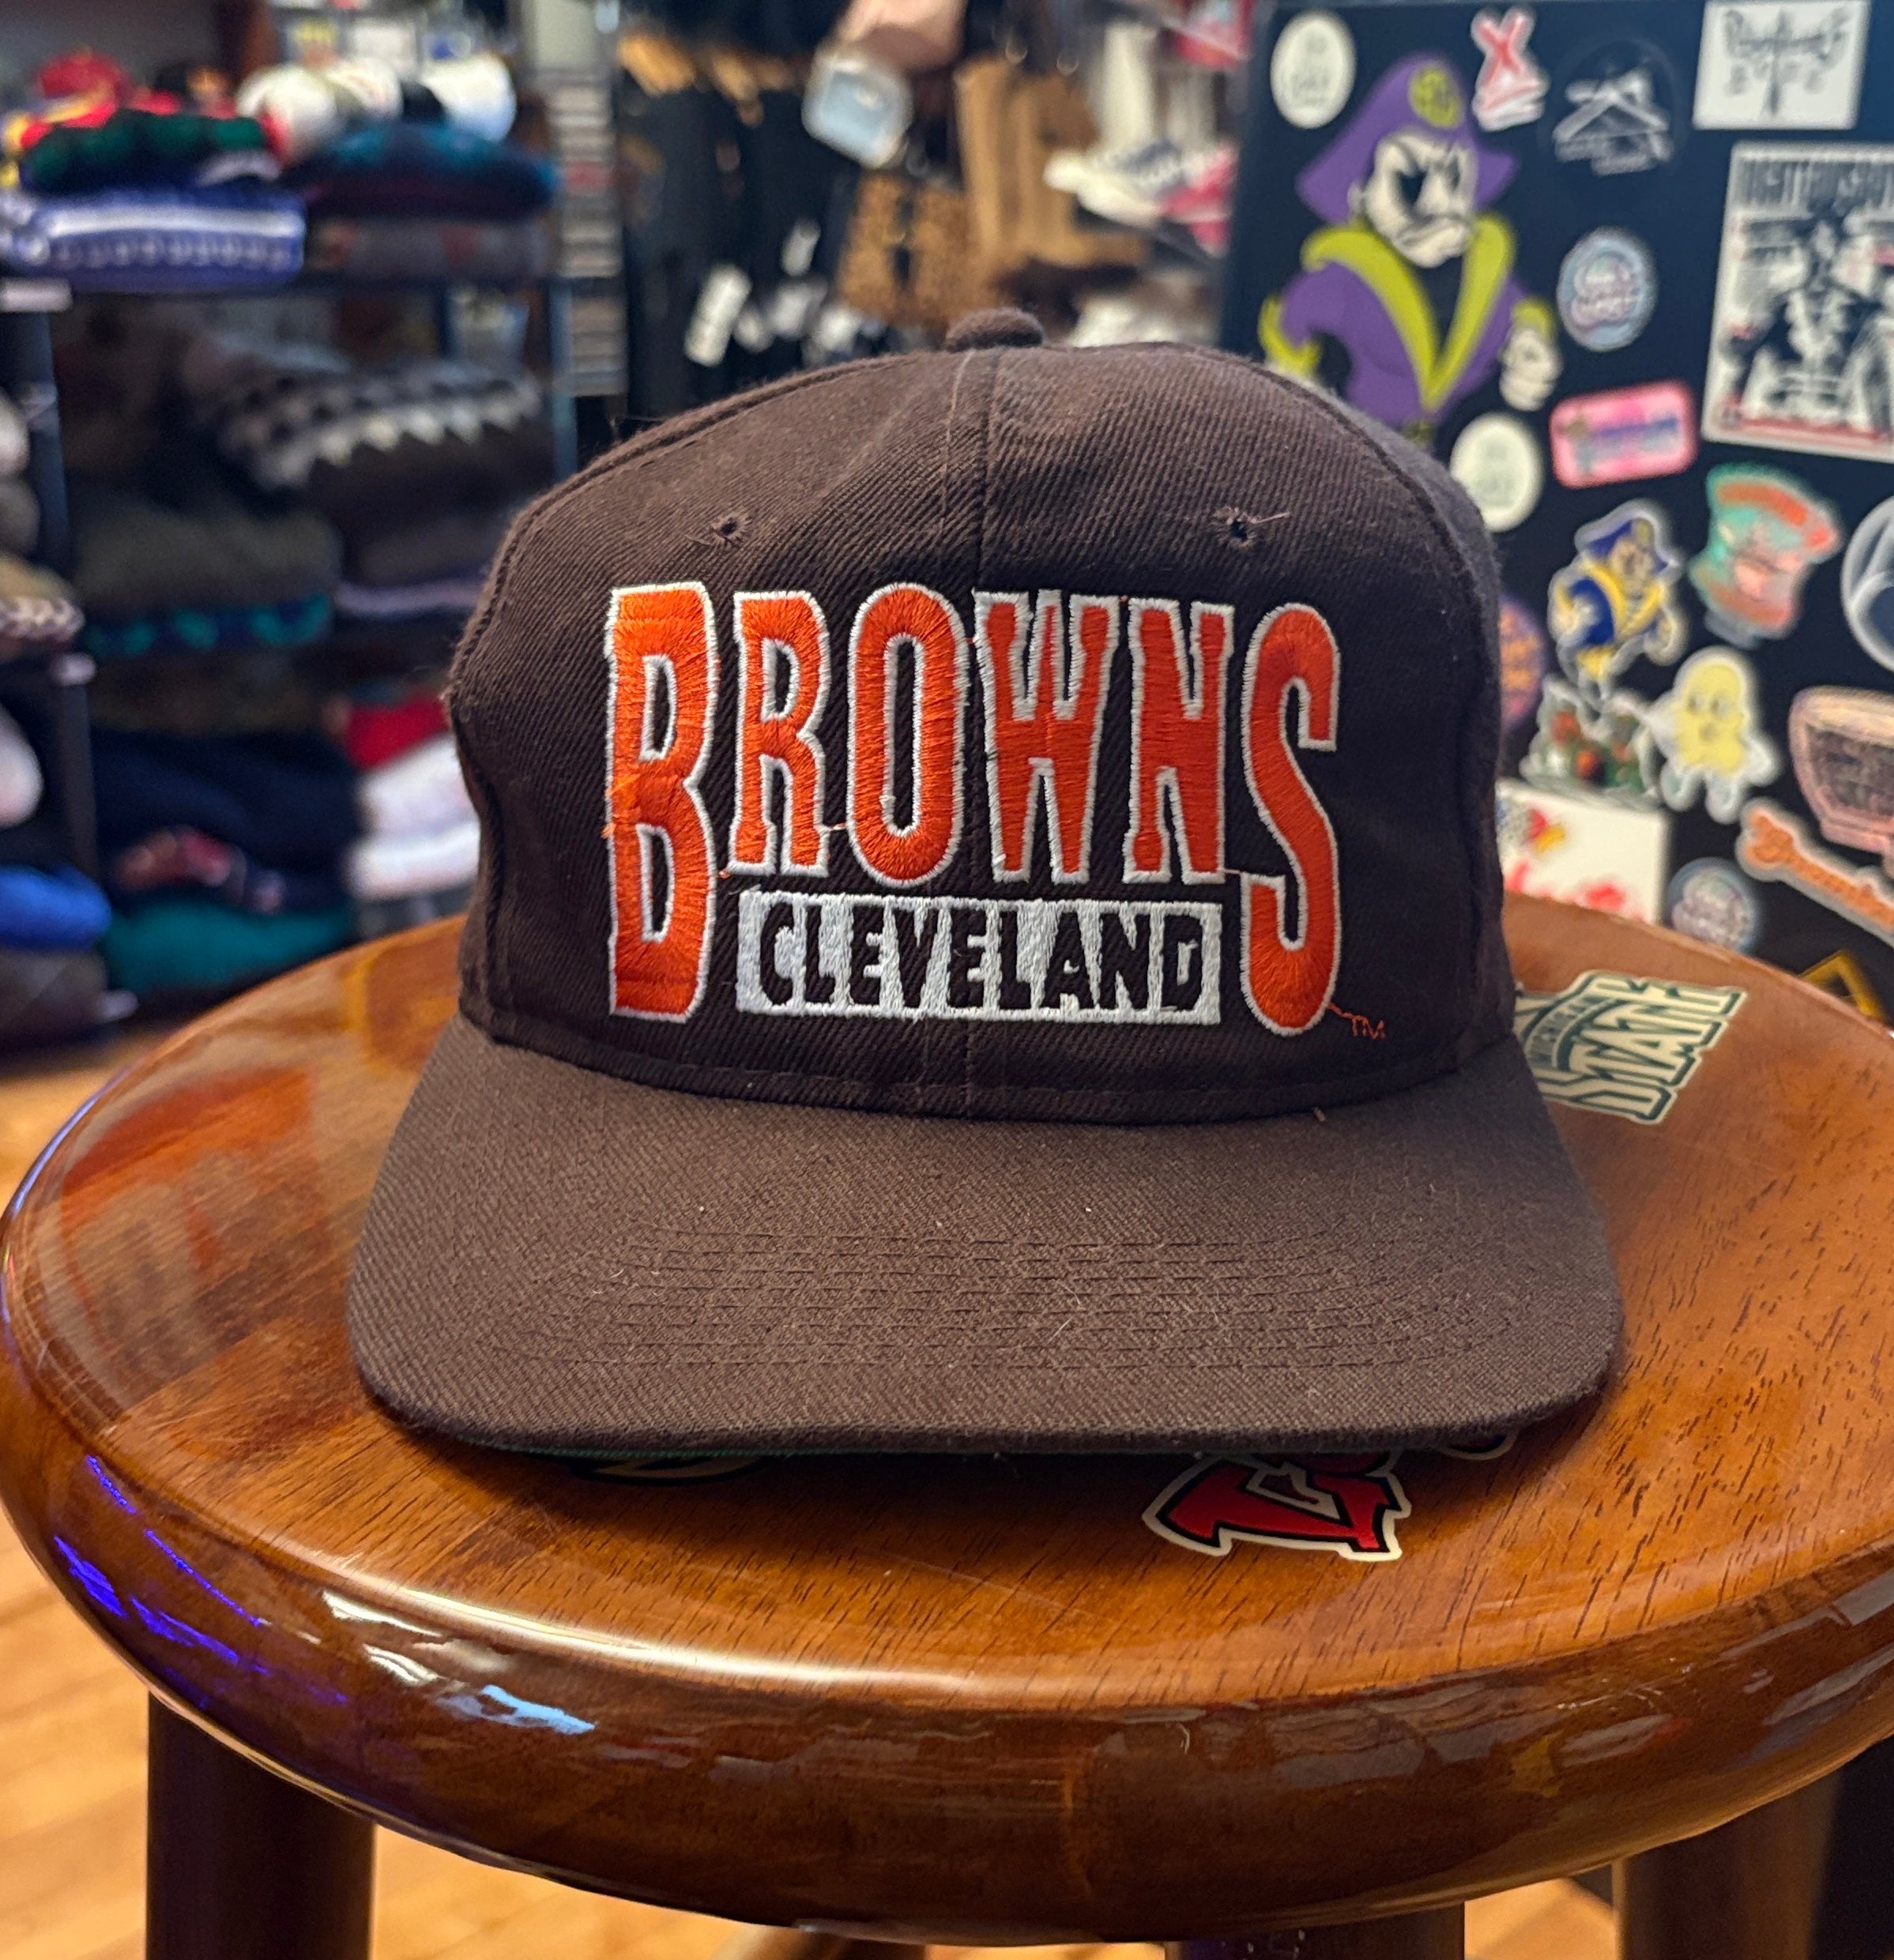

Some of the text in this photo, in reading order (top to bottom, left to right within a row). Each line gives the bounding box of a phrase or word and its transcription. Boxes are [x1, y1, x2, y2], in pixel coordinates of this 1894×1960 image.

[605, 581, 1342, 1036] BROWNS
[759, 901, 1204, 1011] CLEVELAND
[1351, 1015, 1385, 1040] TM
[1537, 973, 1742, 1120] STATE
